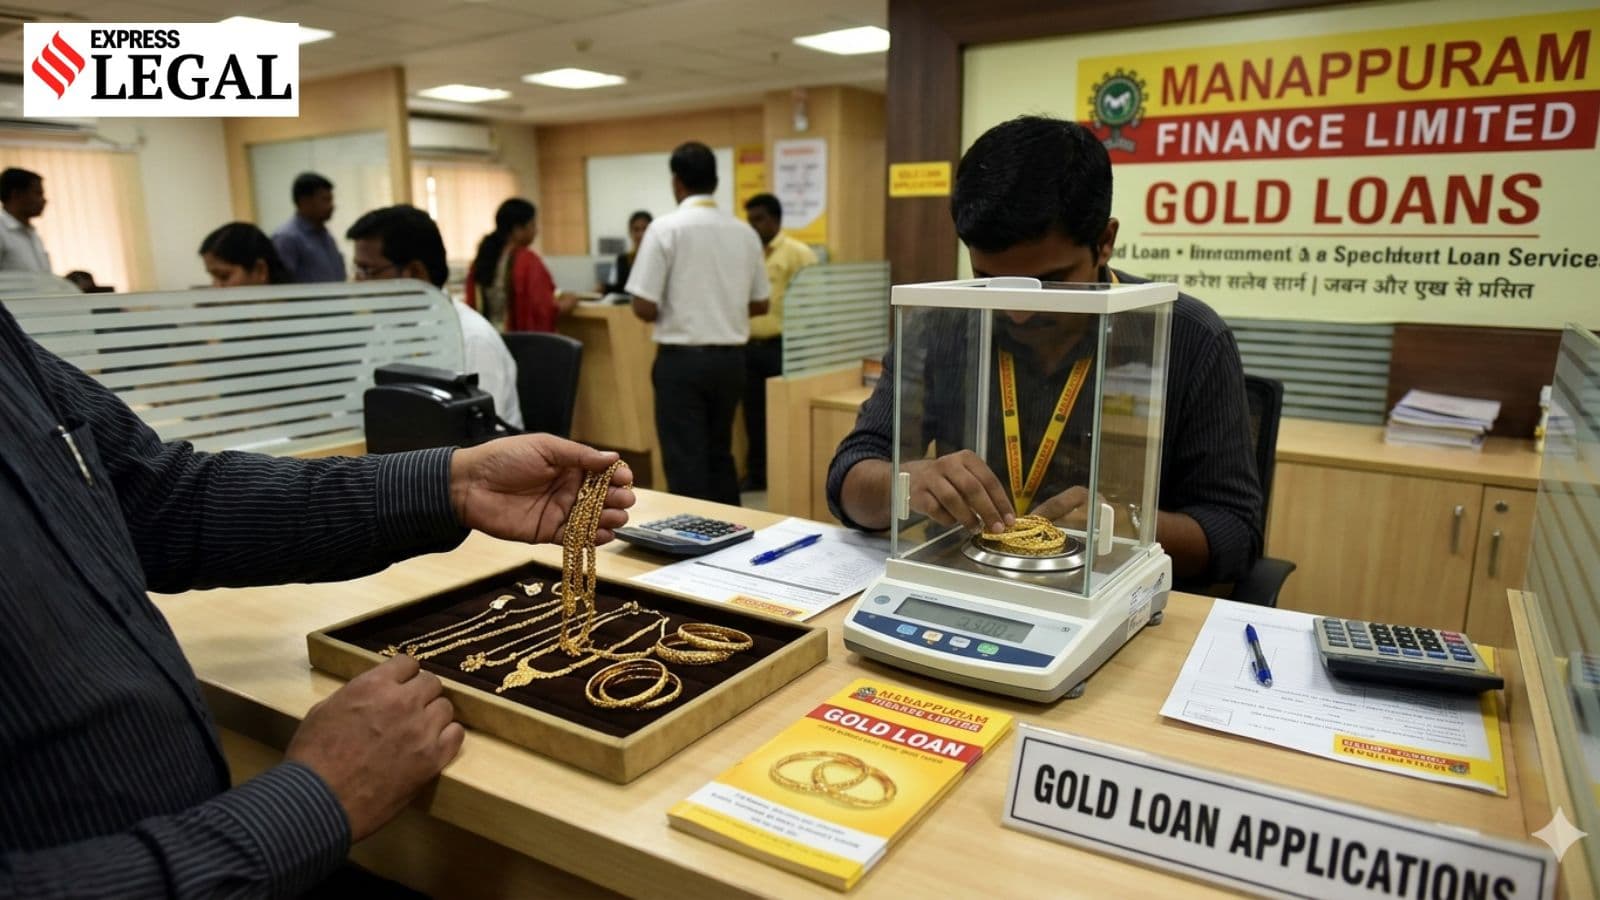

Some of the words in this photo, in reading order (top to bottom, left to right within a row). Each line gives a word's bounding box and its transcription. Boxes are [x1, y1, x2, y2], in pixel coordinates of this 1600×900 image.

[1161, 30, 1592, 107] MANAPPURAM
[1156, 113, 1345, 156] FINANCE
[1364, 101, 1577, 148] LIMITED
[1145, 178, 1292, 226] GOLD
[1313, 172, 1543, 226] LOANS
[1131, 246, 1171, 260] Loan
[1447, 249, 1502, 267] Loan
[1507, 247, 1600, 269] Service
[823, 708, 893, 736] GOLD
[890, 728, 967, 759] LOAN
[1033, 763, 1120, 820] GOLD
[1128, 786, 1222, 849] LOAN
[1228, 813, 1517, 900] APPLICATIONS
